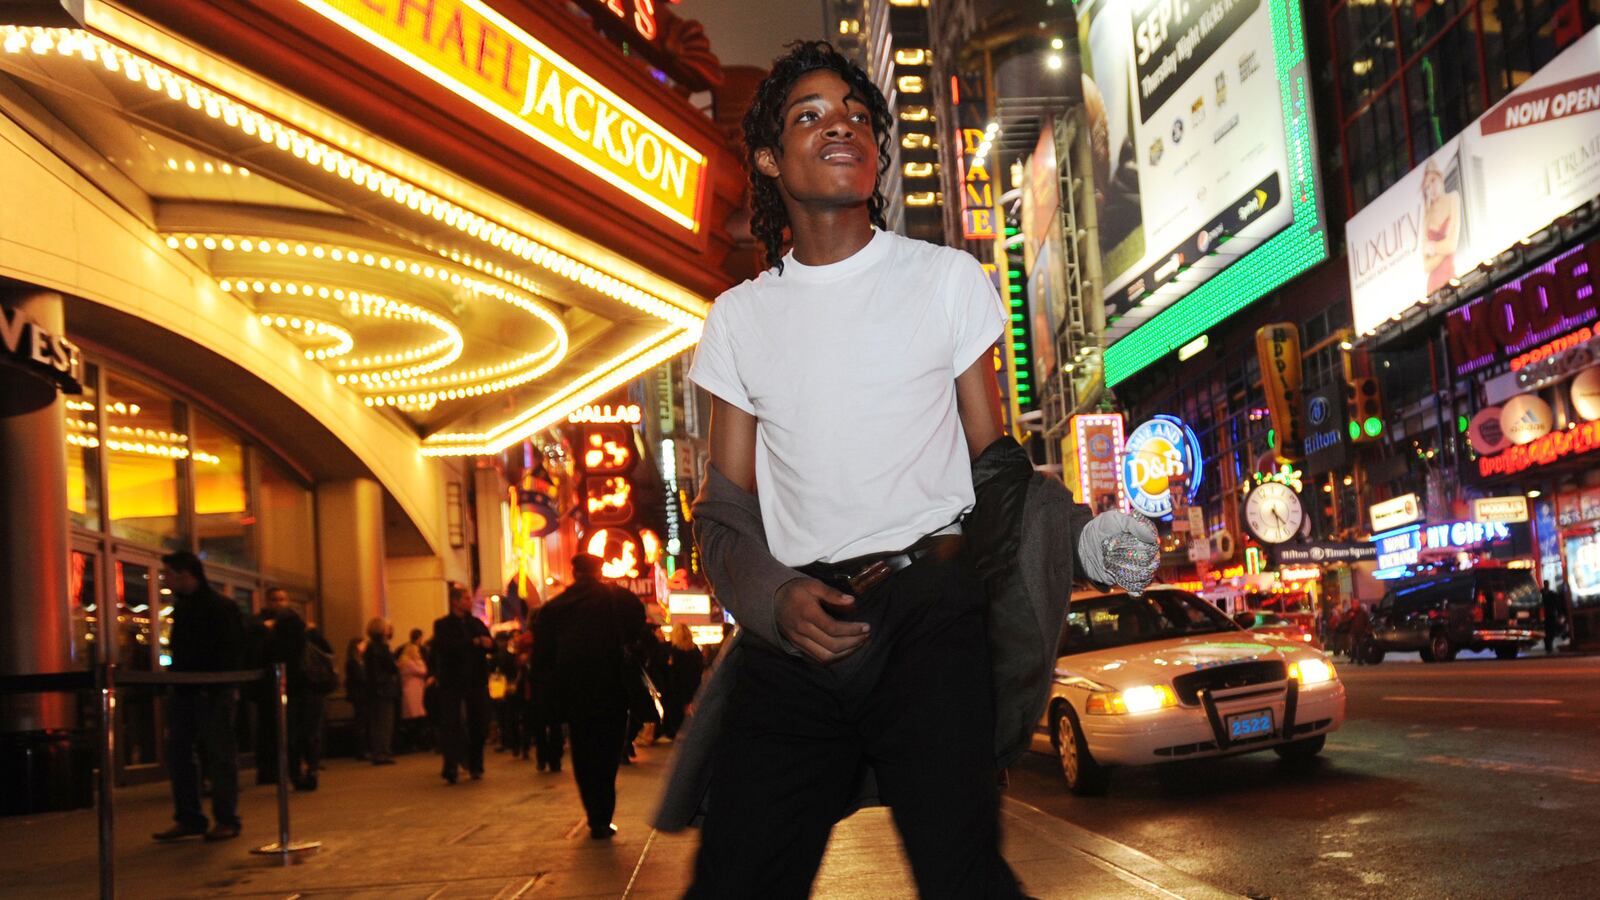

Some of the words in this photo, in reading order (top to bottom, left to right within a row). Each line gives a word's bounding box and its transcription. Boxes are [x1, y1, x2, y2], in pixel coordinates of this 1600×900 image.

[1141, 50, 1178, 99] Thursday
[1175, 24, 1200, 63] Night
[357, 0, 526, 98] HAEL
[520, 53, 690, 200] JACKSON
[1505, 98, 1550, 128] NOW
[1551, 85, 1600, 117] OPEN
[1351, 203, 1422, 280] luxury
[1511, 327, 1592, 372] SPORTING
[1155, 423, 1180, 446] AND
[1303, 429, 1342, 456] Hilton
[1128, 449, 1184, 488] D&B
[1427, 524, 1449, 548] NY
[1451, 520, 1511, 547] GIFTS
[1281, 550, 1309, 560] Hilton
[1324, 548, 1349, 559] Times
[1232, 716, 1271, 736] 2522
